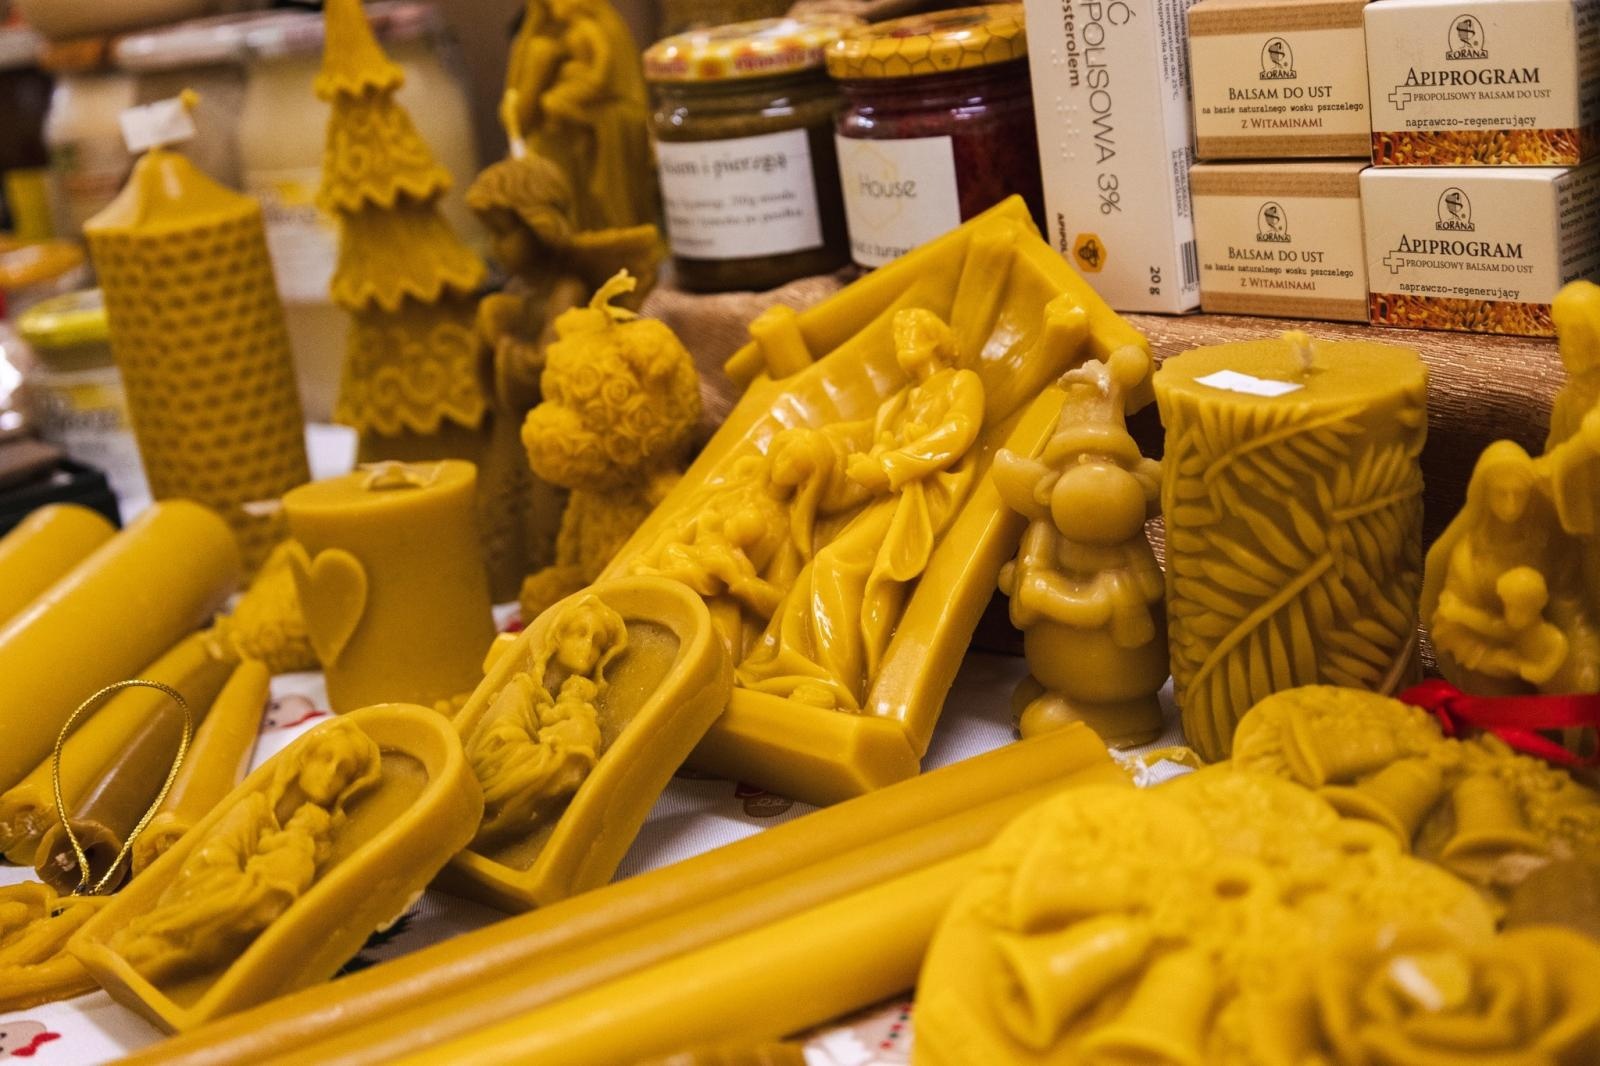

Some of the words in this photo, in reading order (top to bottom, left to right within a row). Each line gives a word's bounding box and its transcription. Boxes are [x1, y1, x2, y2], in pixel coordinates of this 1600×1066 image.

[1107, 0, 1136, 26] Ć
[1283, 87, 1304, 99] DO
[1308, 86, 1332, 98] UST
[1413, 92, 1476, 101] PROPOLISOWY
[1479, 91, 1515, 100] BALSAM
[1517, 90, 1532, 99] DO
[1533, 89, 1552, 98] UST
[1080, 0, 1116, 164] POLISOWA
[1098, 173, 1122, 215] 3%
[1214, 106, 1235, 114] bazie
[1239, 105, 1287, 115] naturalnego
[1290, 104, 1313, 112] wosku
[1317, 102, 1364, 113] pszczelego
[1405, 116, 1536, 128] naprawczo-regenerujący
[1279, 250, 1298, 262] DO
[1301, 251, 1324, 263] UST
[1238, 265, 1282, 275] naturalnego
[1286, 267, 1307, 276] wosku
[1310, 267, 1354, 278] pszczelego
[1406, 259, 1464, 270] PROPOLISOWY
[1466, 263, 1500, 272] BALSAM
[1501, 264, 1515, 273] DO
[1516, 265, 1533, 274] UST
[1150, 266, 1161, 284] 20
[1149, 287, 1160, 296] g
[1400, 283, 1520, 299] naprawczo-regenerujący
